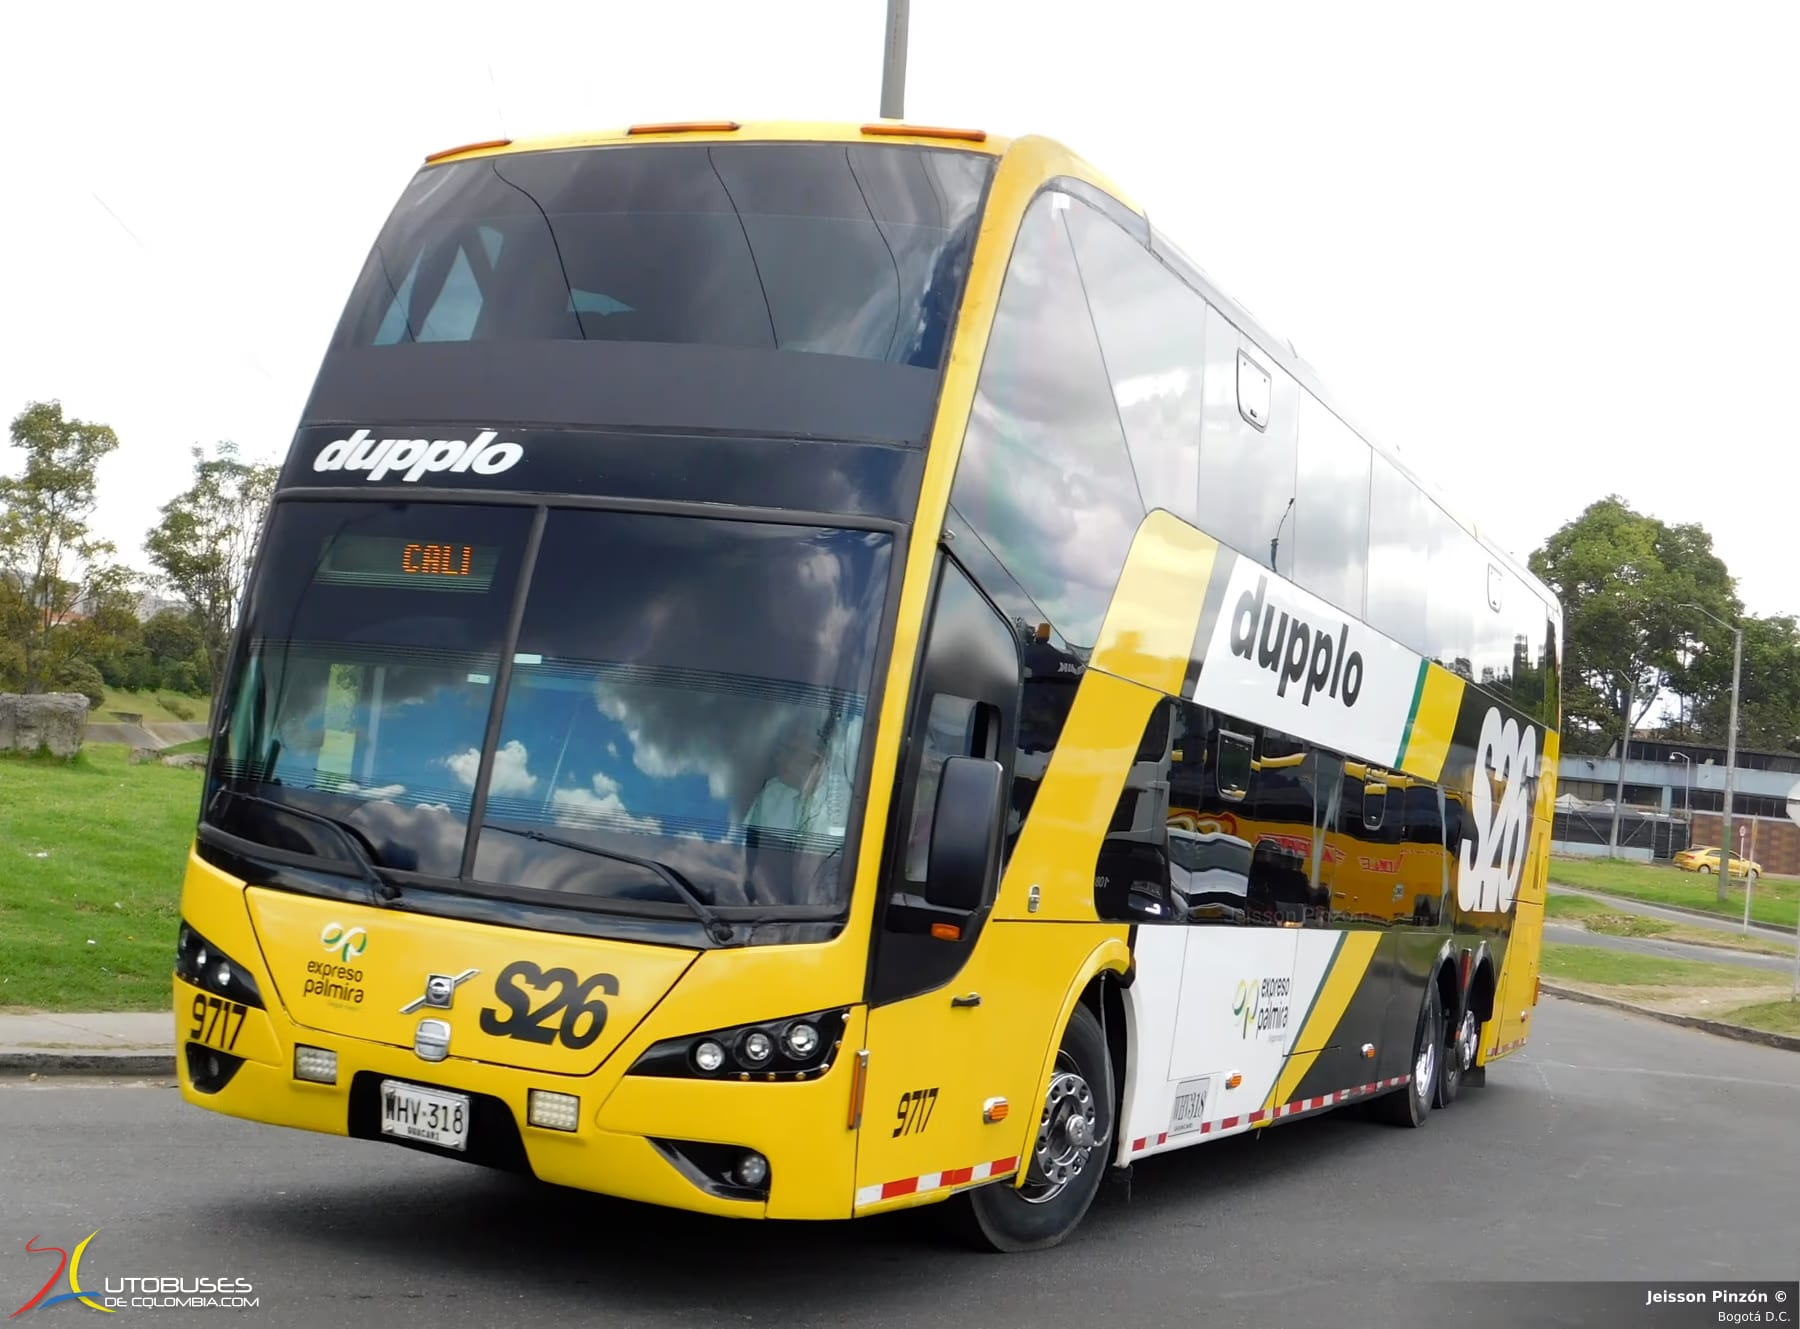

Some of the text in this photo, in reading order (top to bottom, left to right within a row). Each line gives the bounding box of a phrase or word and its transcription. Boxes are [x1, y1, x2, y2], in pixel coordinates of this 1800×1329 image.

[313, 429, 524, 482] dupplo
[402, 544, 472, 575] CALI
[1230, 573, 1363, 707] dupplo
[1458, 705, 1536, 914] S26
[303, 978, 364, 1003] palmira
[307, 960, 363, 982] expreso
[1262, 977, 1290, 1002] expreso
[190, 993, 247, 1051] 9717
[479, 961, 619, 1050] S26
[1256, 1001, 1288, 1040] palmira
[892, 1087, 939, 1138] 9717
